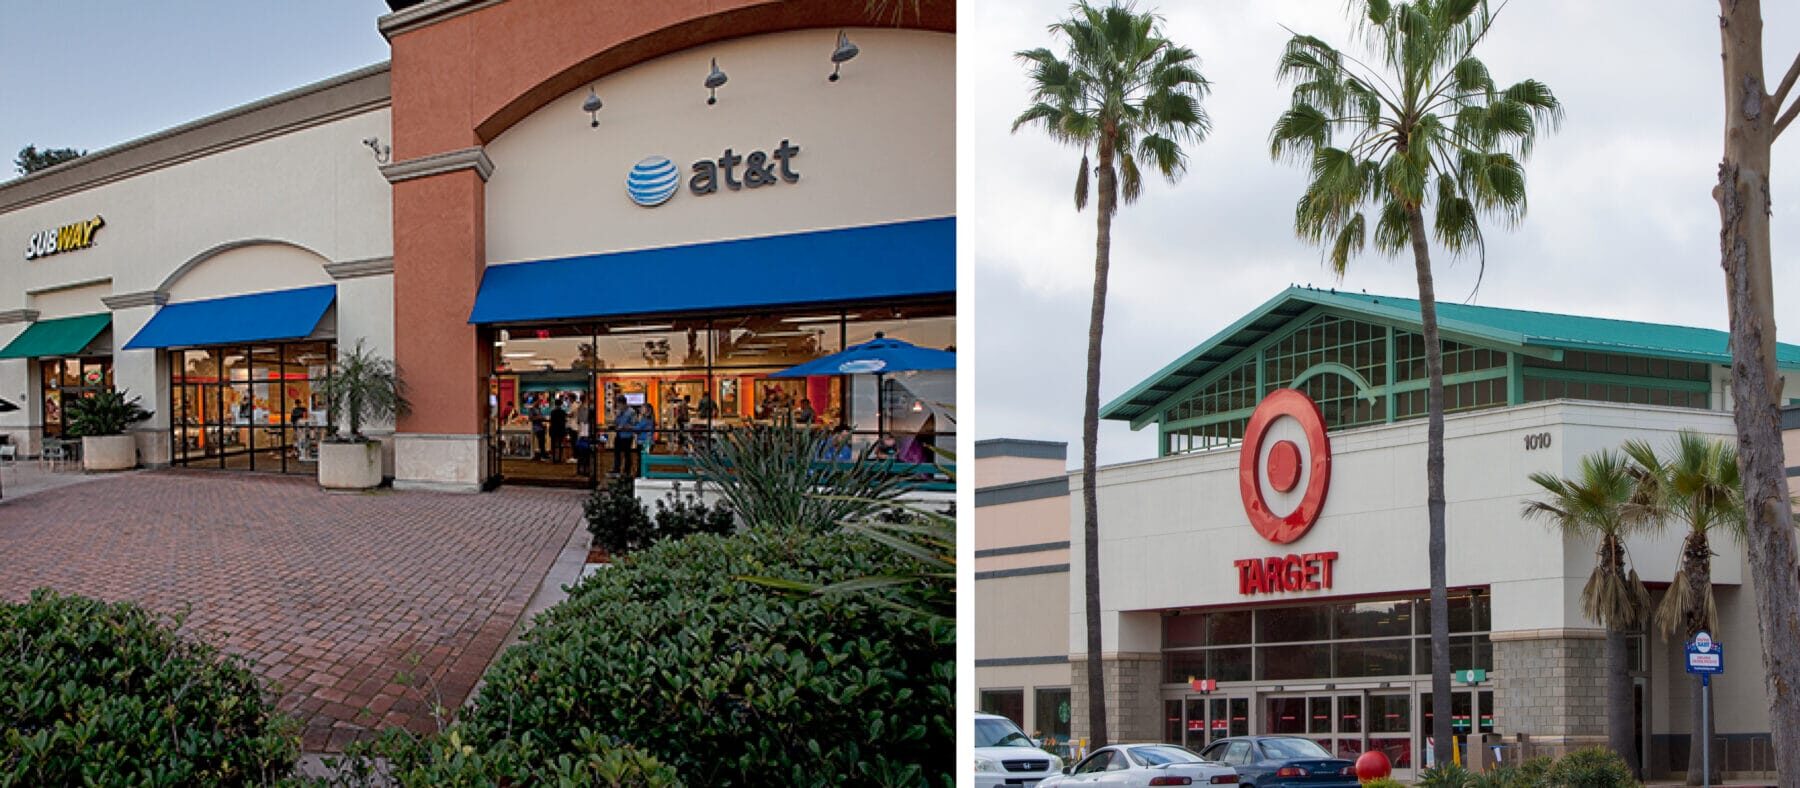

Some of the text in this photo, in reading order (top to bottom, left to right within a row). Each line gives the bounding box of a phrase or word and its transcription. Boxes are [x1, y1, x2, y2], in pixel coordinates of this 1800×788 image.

[690, 139, 799, 195] at&t
[25, 213, 104, 260] SUBWAY
[1524, 432, 1551, 450] 1010
[1234, 551, 1338, 595] TARGET
